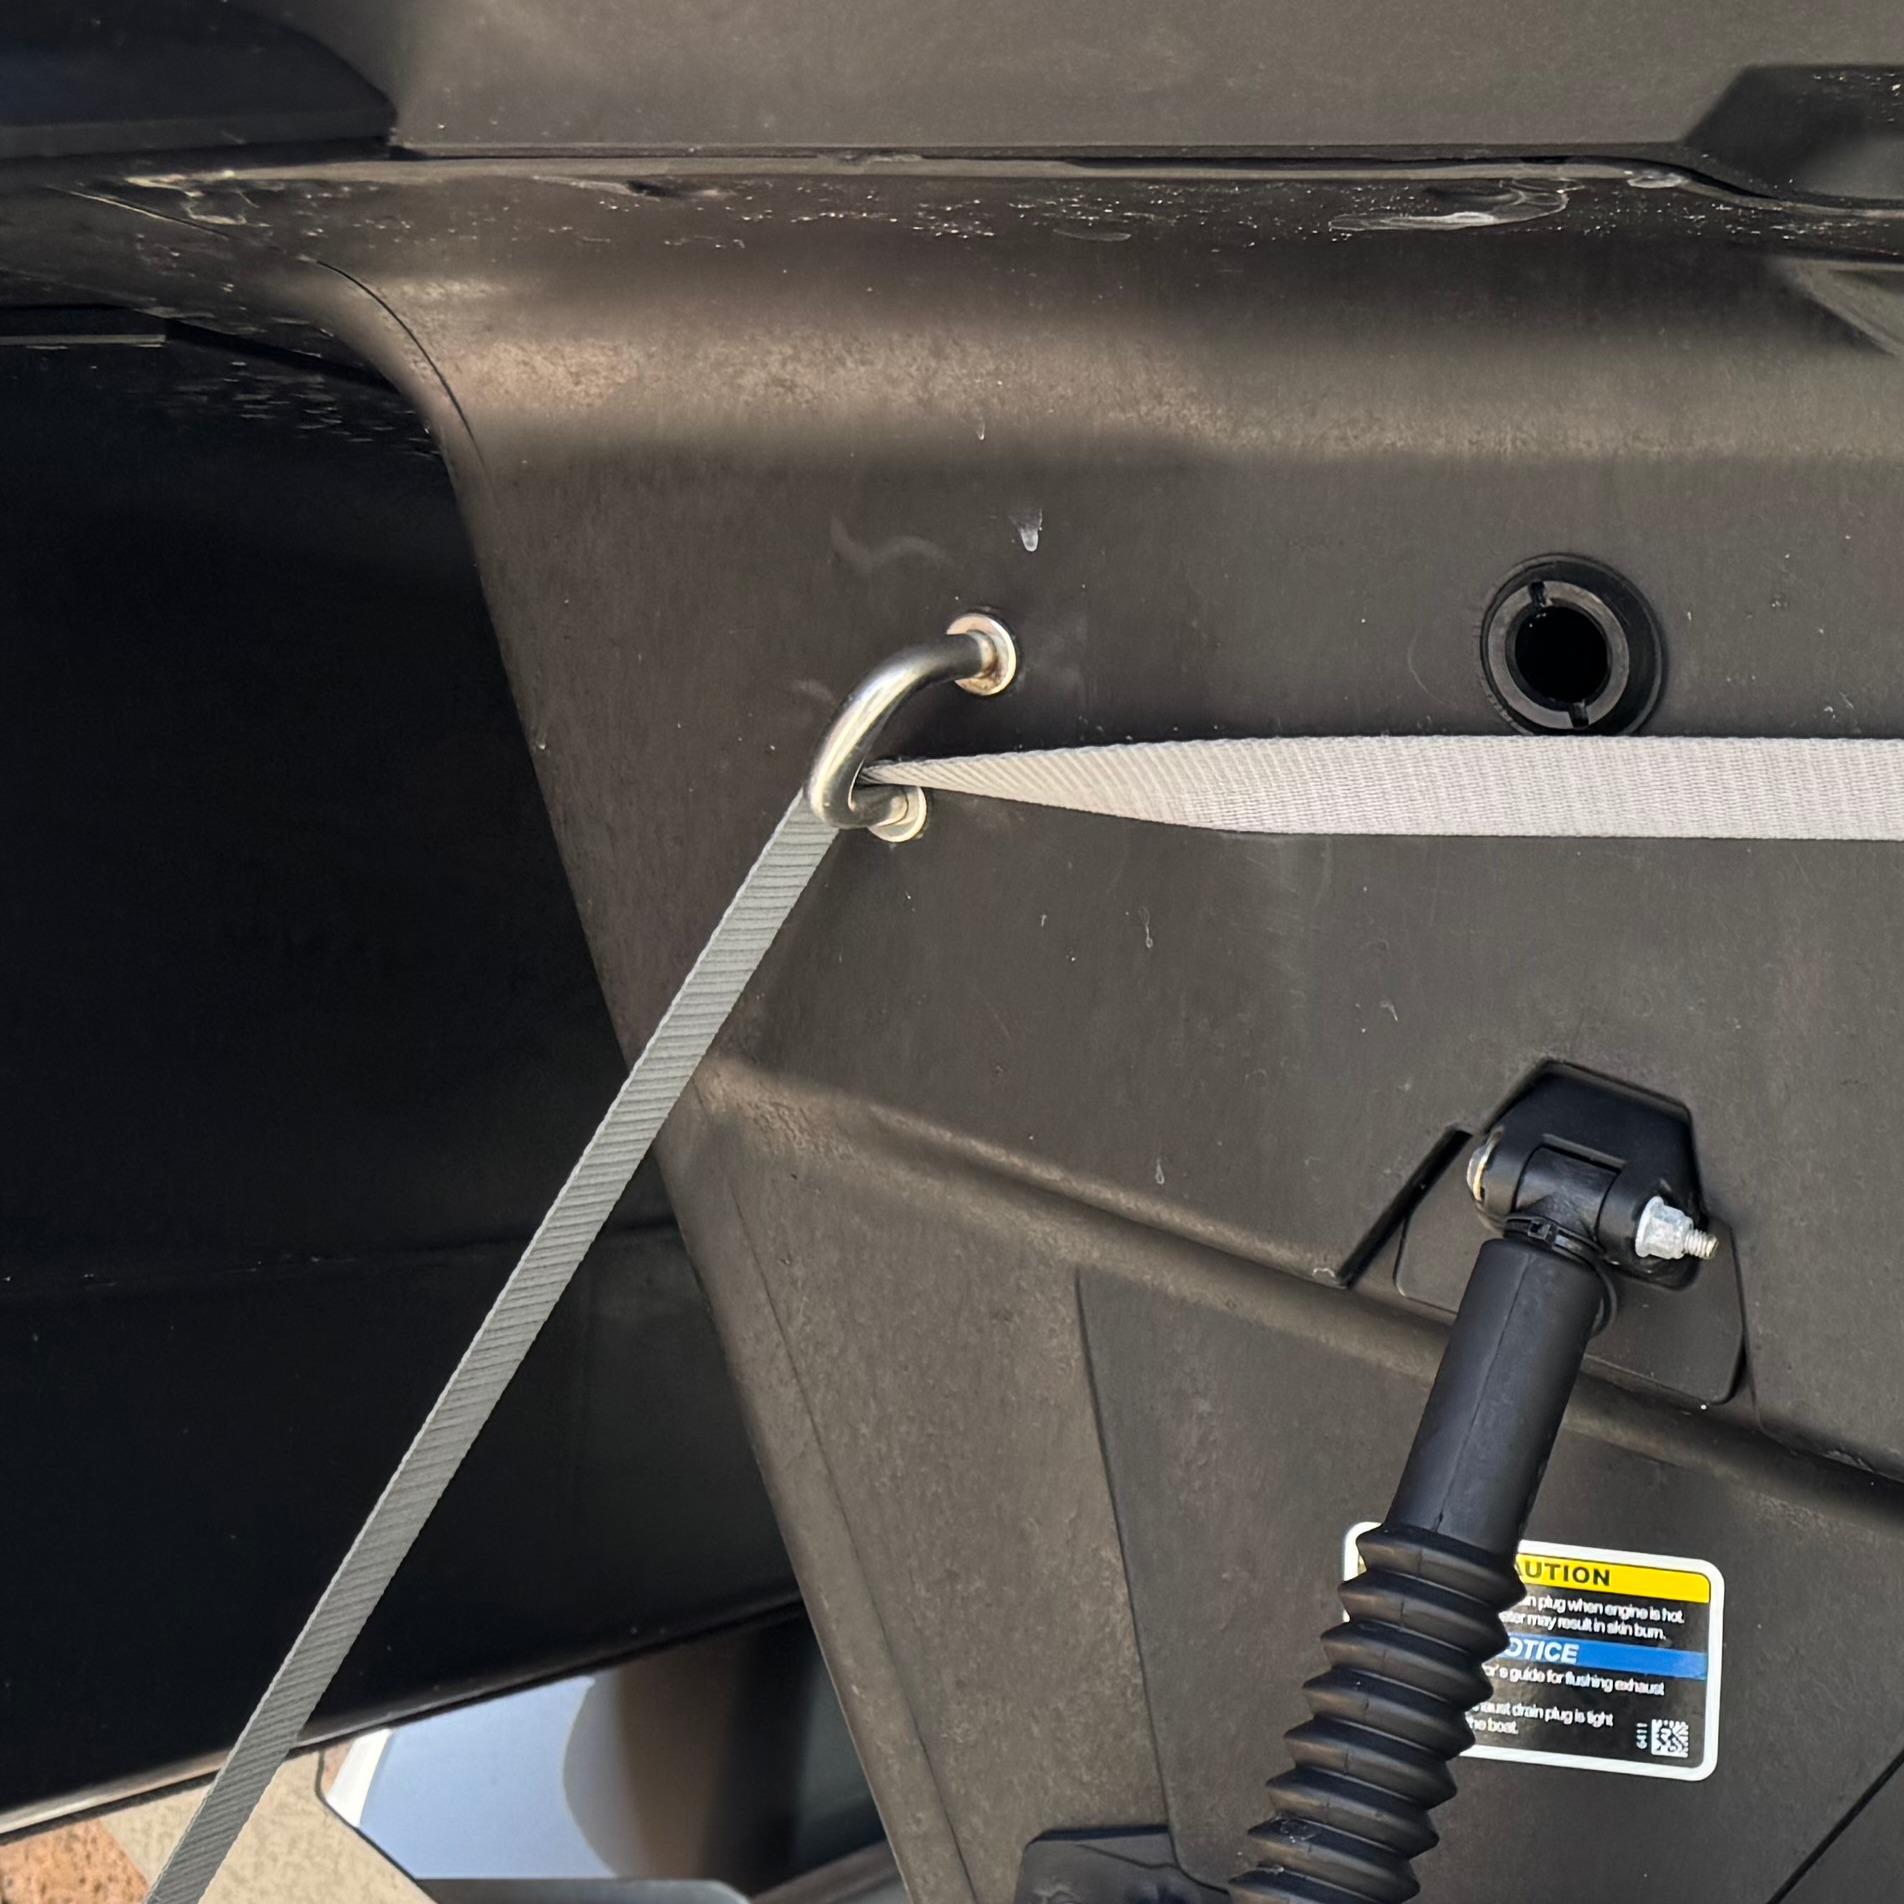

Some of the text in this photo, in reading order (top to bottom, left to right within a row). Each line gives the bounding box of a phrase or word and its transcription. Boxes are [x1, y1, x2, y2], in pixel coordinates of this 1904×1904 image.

[1517, 1560, 1611, 1587] UTION
[1538, 1594, 1566, 1613] plug
[1567, 1598, 1603, 1615] when
[1604, 1604, 1649, 1620] engine
[1649, 1606, 1660, 1621] is
[1661, 1607, 1685, 1624] hot.
[1527, 1614, 1556, 1631] may
[1558, 1617, 1592, 1632] result
[1593, 1617, 1606, 1633] in
[1606, 1620, 1633, 1636] skin
[1633, 1622, 1666, 1640] burn.
[1505, 1637, 1580, 1664] OTICE
[1509, 1666, 1545, 1683] guide
[1546, 1669, 1564, 1684] for
[1565, 1671, 1614, 1693] flushing
[1615, 1678, 1664, 1696] exhaust
[1487, 1717, 1519, 1735] boat.
[1511, 1702, 1543, 1719] drain
[1544, 1706, 1573, 1725] plug
[1574, 1708, 1585, 1723] is
[1586, 1710, 1614, 1728] tight
